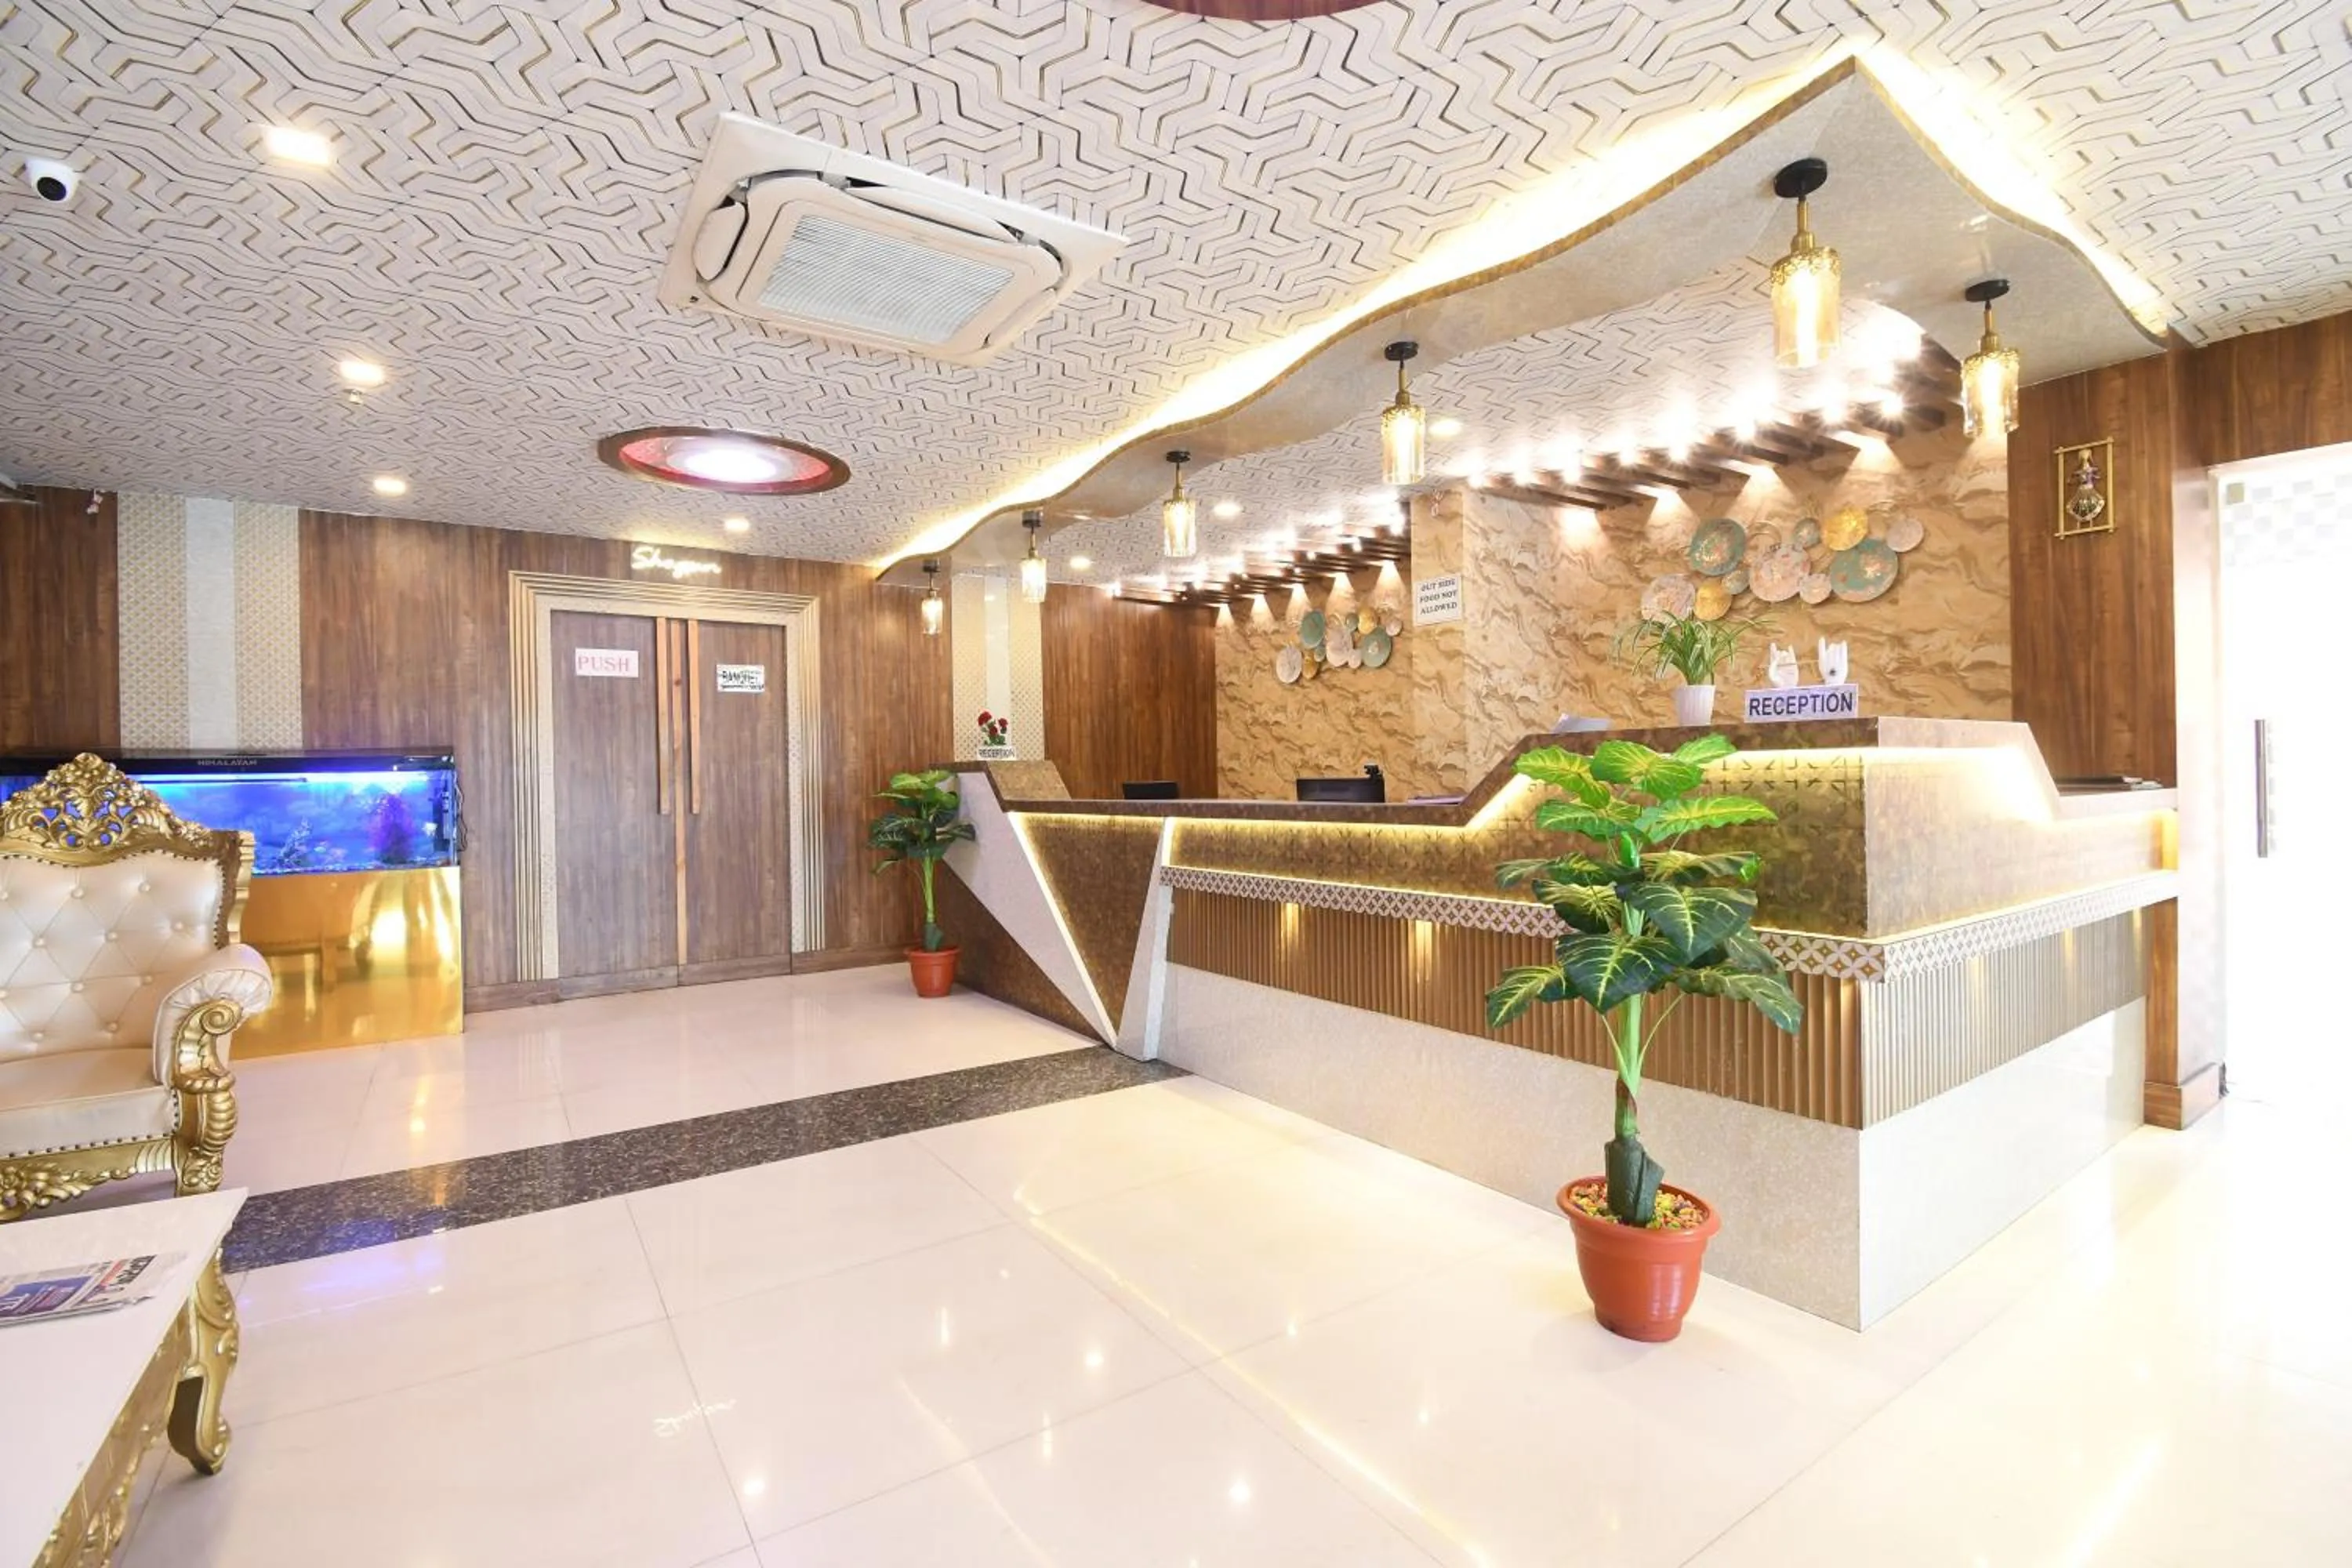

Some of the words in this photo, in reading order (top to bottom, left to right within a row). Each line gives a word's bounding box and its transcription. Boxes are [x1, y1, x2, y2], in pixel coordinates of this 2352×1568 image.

[1420, 594, 1440, 603] FOOD
[1420, 602, 1457, 615] ALLOWED
[578, 656, 628, 672] PUSH
[1749, 693, 1853, 716] RECEPTION
